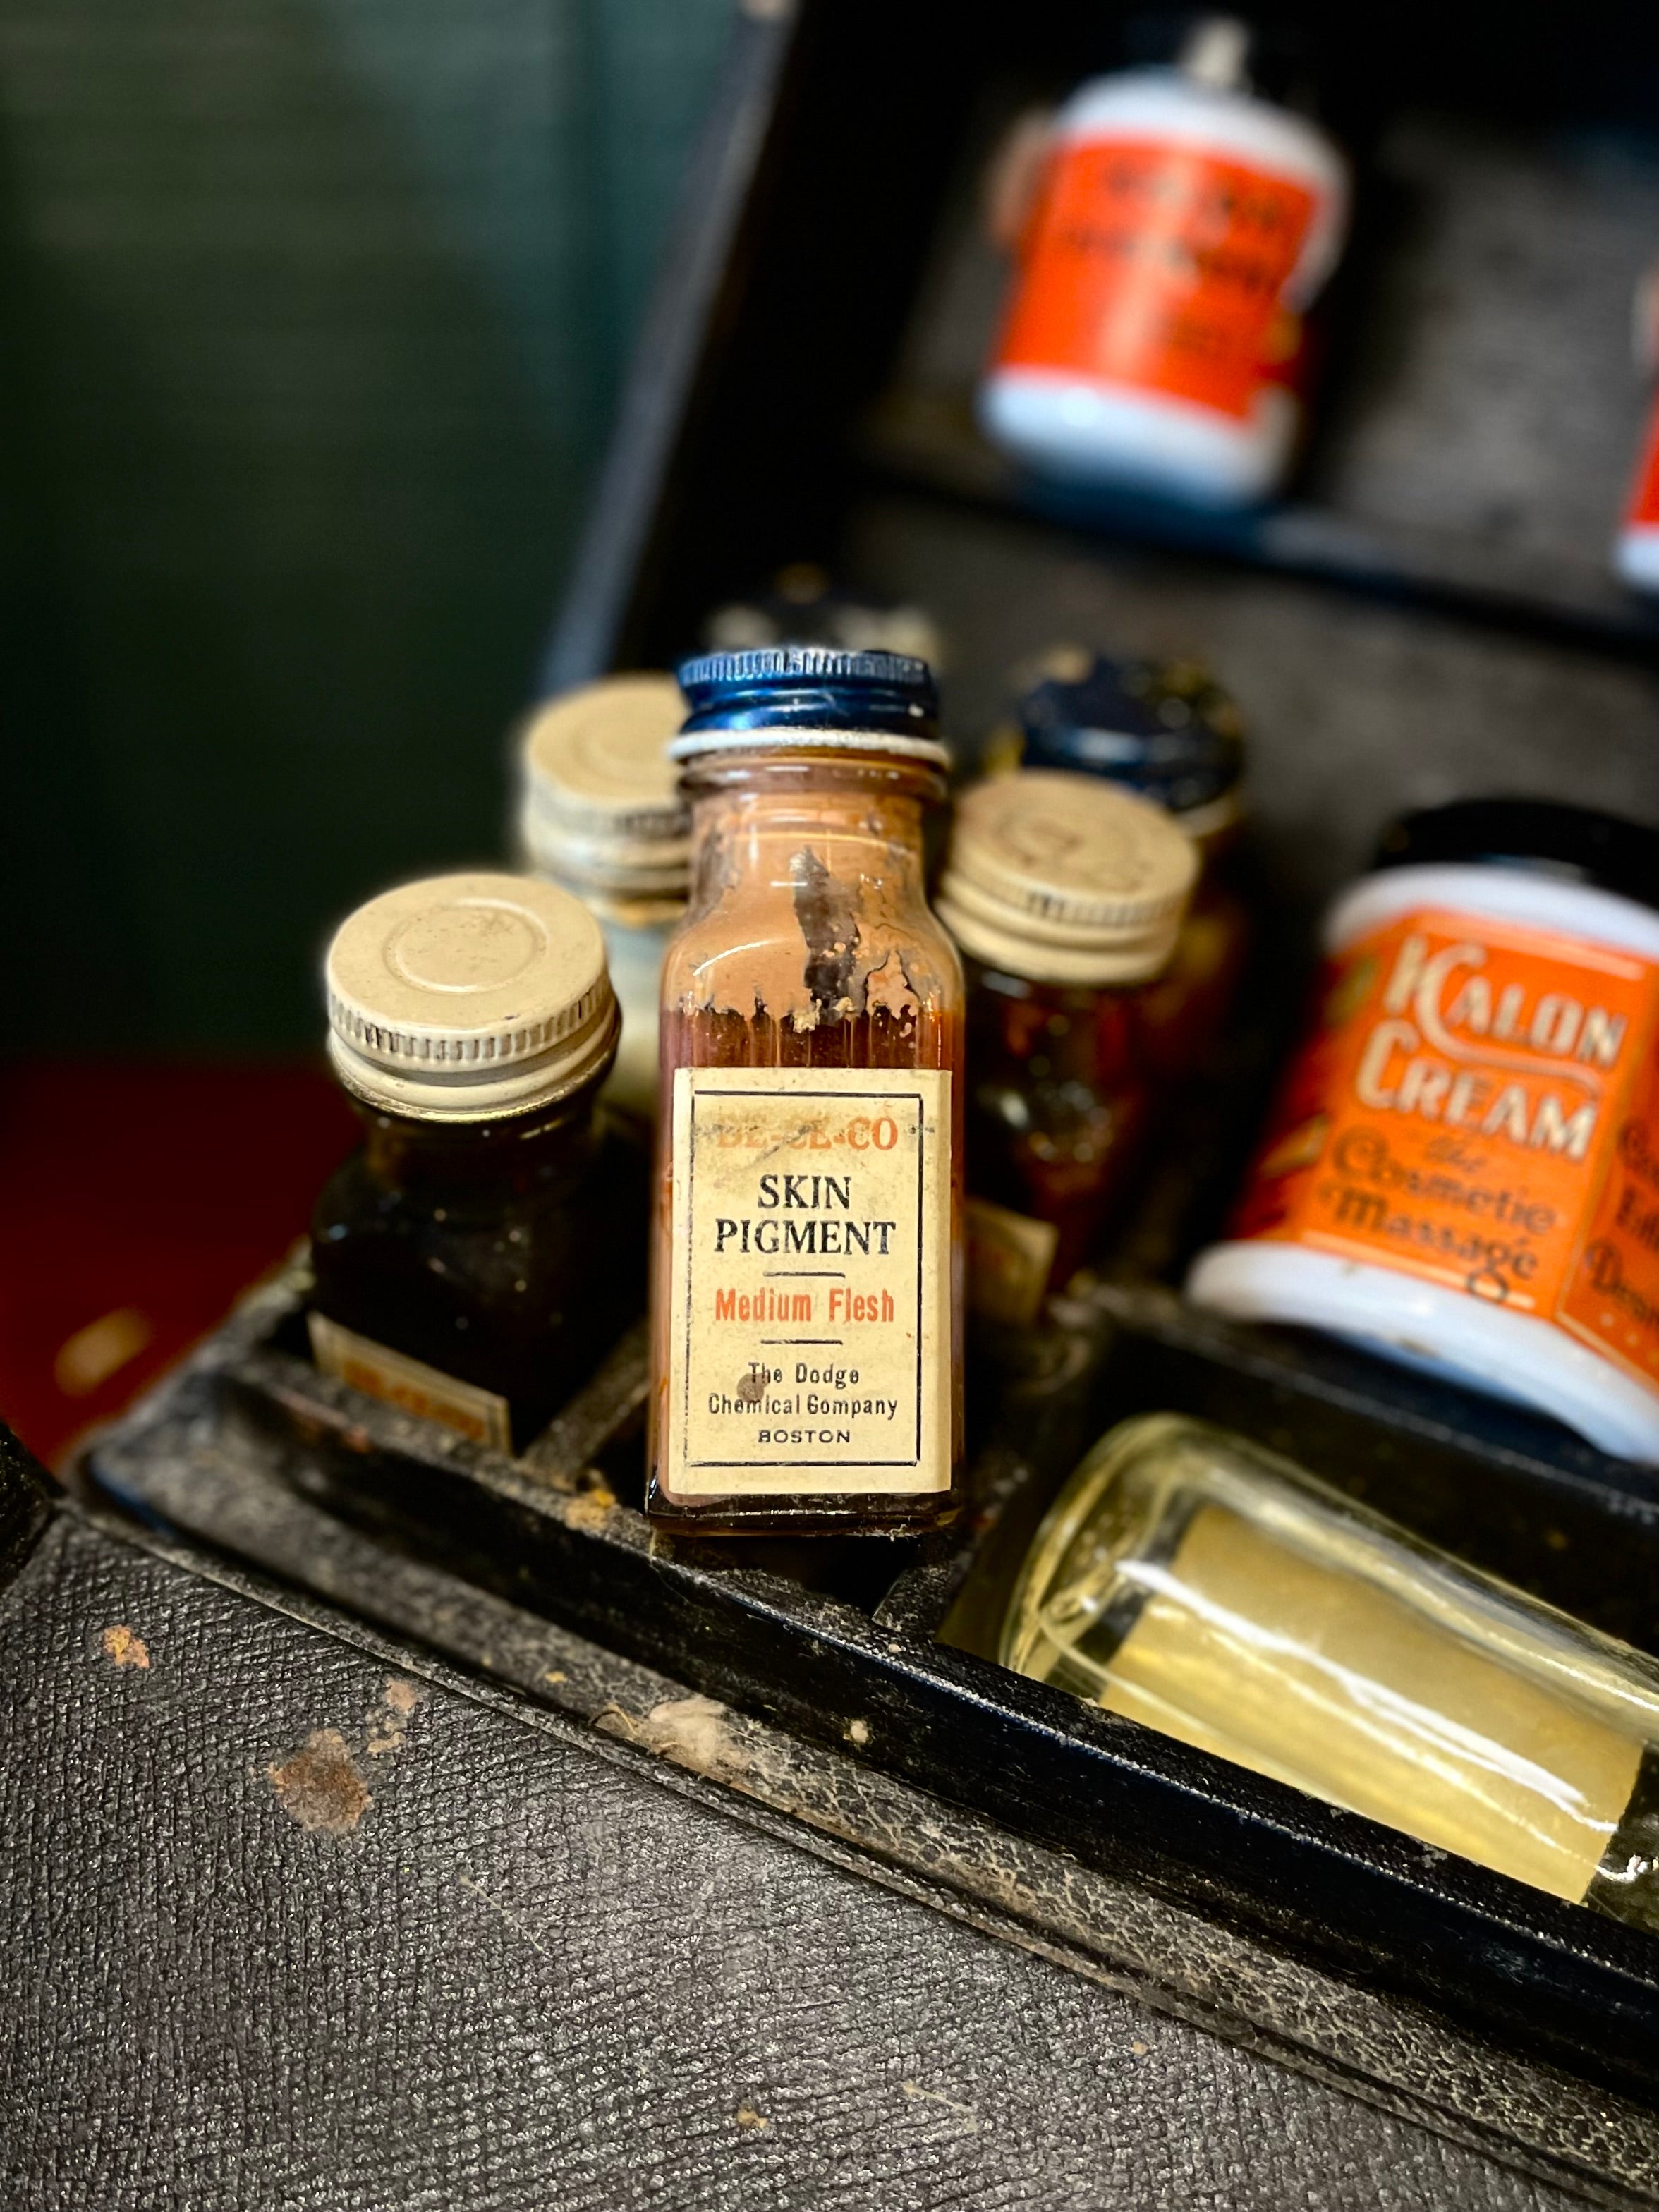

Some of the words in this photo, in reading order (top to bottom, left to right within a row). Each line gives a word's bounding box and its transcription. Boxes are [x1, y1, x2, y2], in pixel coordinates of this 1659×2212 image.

[1382, 932, 1628, 1090] KALON
[1356, 1018, 1598, 1161] CREAM
[758, 1174, 852, 1210] SKIN
[714, 1218, 897, 1256] PIGMENT
[715, 1288, 812, 1323] Medium
[829, 1288, 894, 1323] Flesh
[748, 1361, 783, 1383] The
[795, 1361, 860, 1390] Dodge
[707, 1392, 800, 1414] Chemical
[807, 1393, 898, 1421] Company
[758, 1429, 851, 1444] BOSTON
